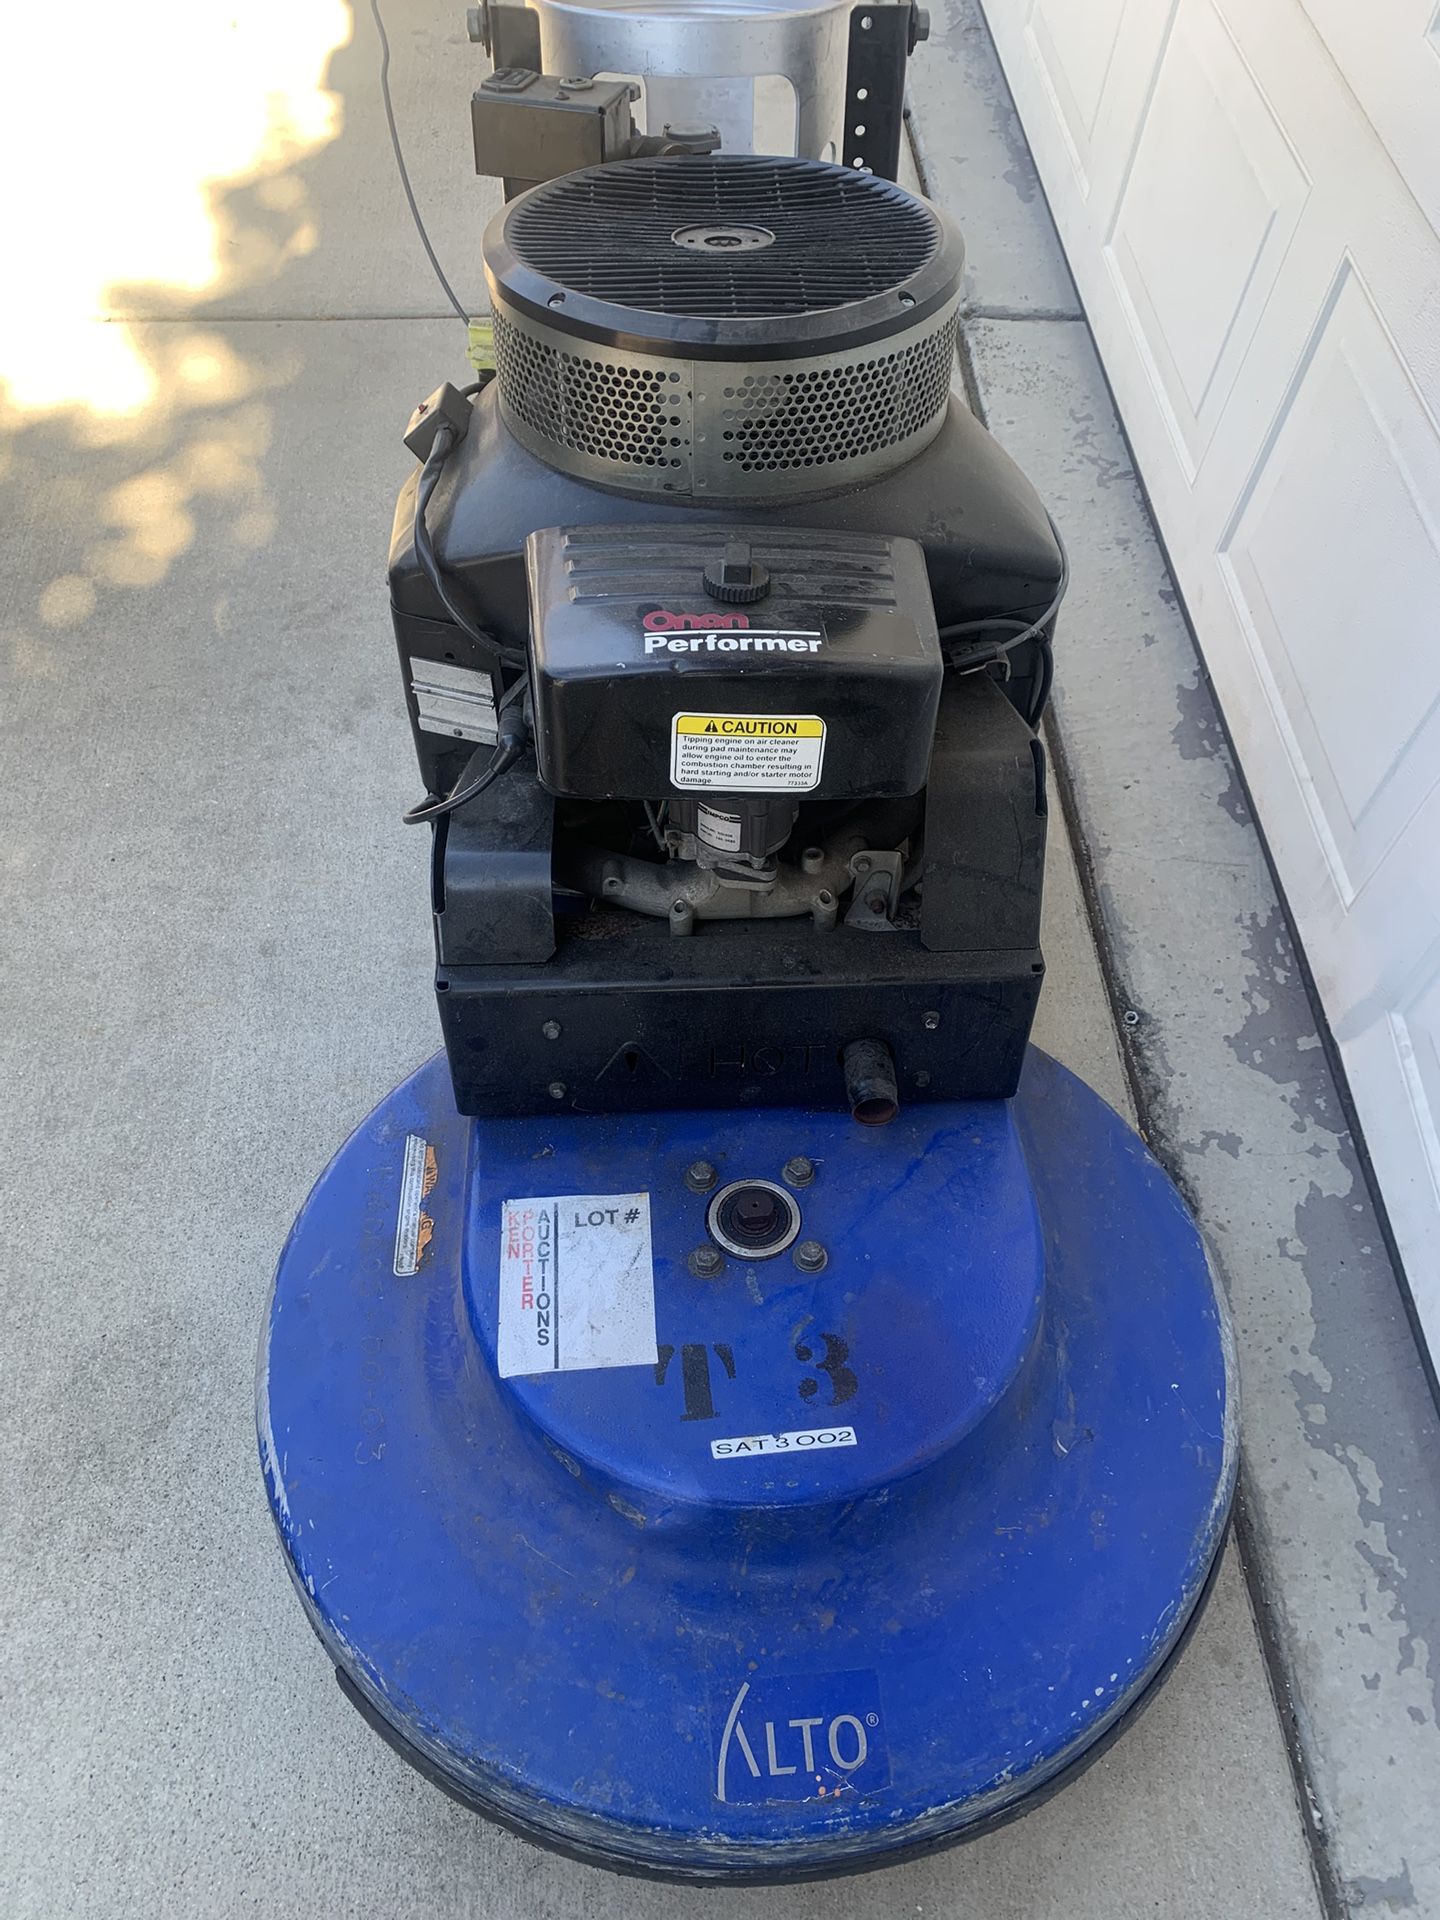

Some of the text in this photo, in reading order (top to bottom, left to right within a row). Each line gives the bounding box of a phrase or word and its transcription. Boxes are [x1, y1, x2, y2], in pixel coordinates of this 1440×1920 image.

[643, 610, 749, 631] Onan
[644, 634, 822, 654] Performer
[722, 721, 797, 734] CAUTION
[682, 744, 708, 752] during
[683, 736, 713, 744] Tipping
[681, 760, 728, 768] combustion
[767, 763, 802, 771] resulting
[709, 1042, 827, 1078] HOT
[575, 1208, 641, 1228] LOT #
[506, 1211, 520, 1259] KEN
[522, 1209, 535, 1310] PORTER
[536, 1209, 551, 1347] AUCTIONS
[715, 1438, 769, 1455] SAT
[775, 1437, 790, 1449] 3
